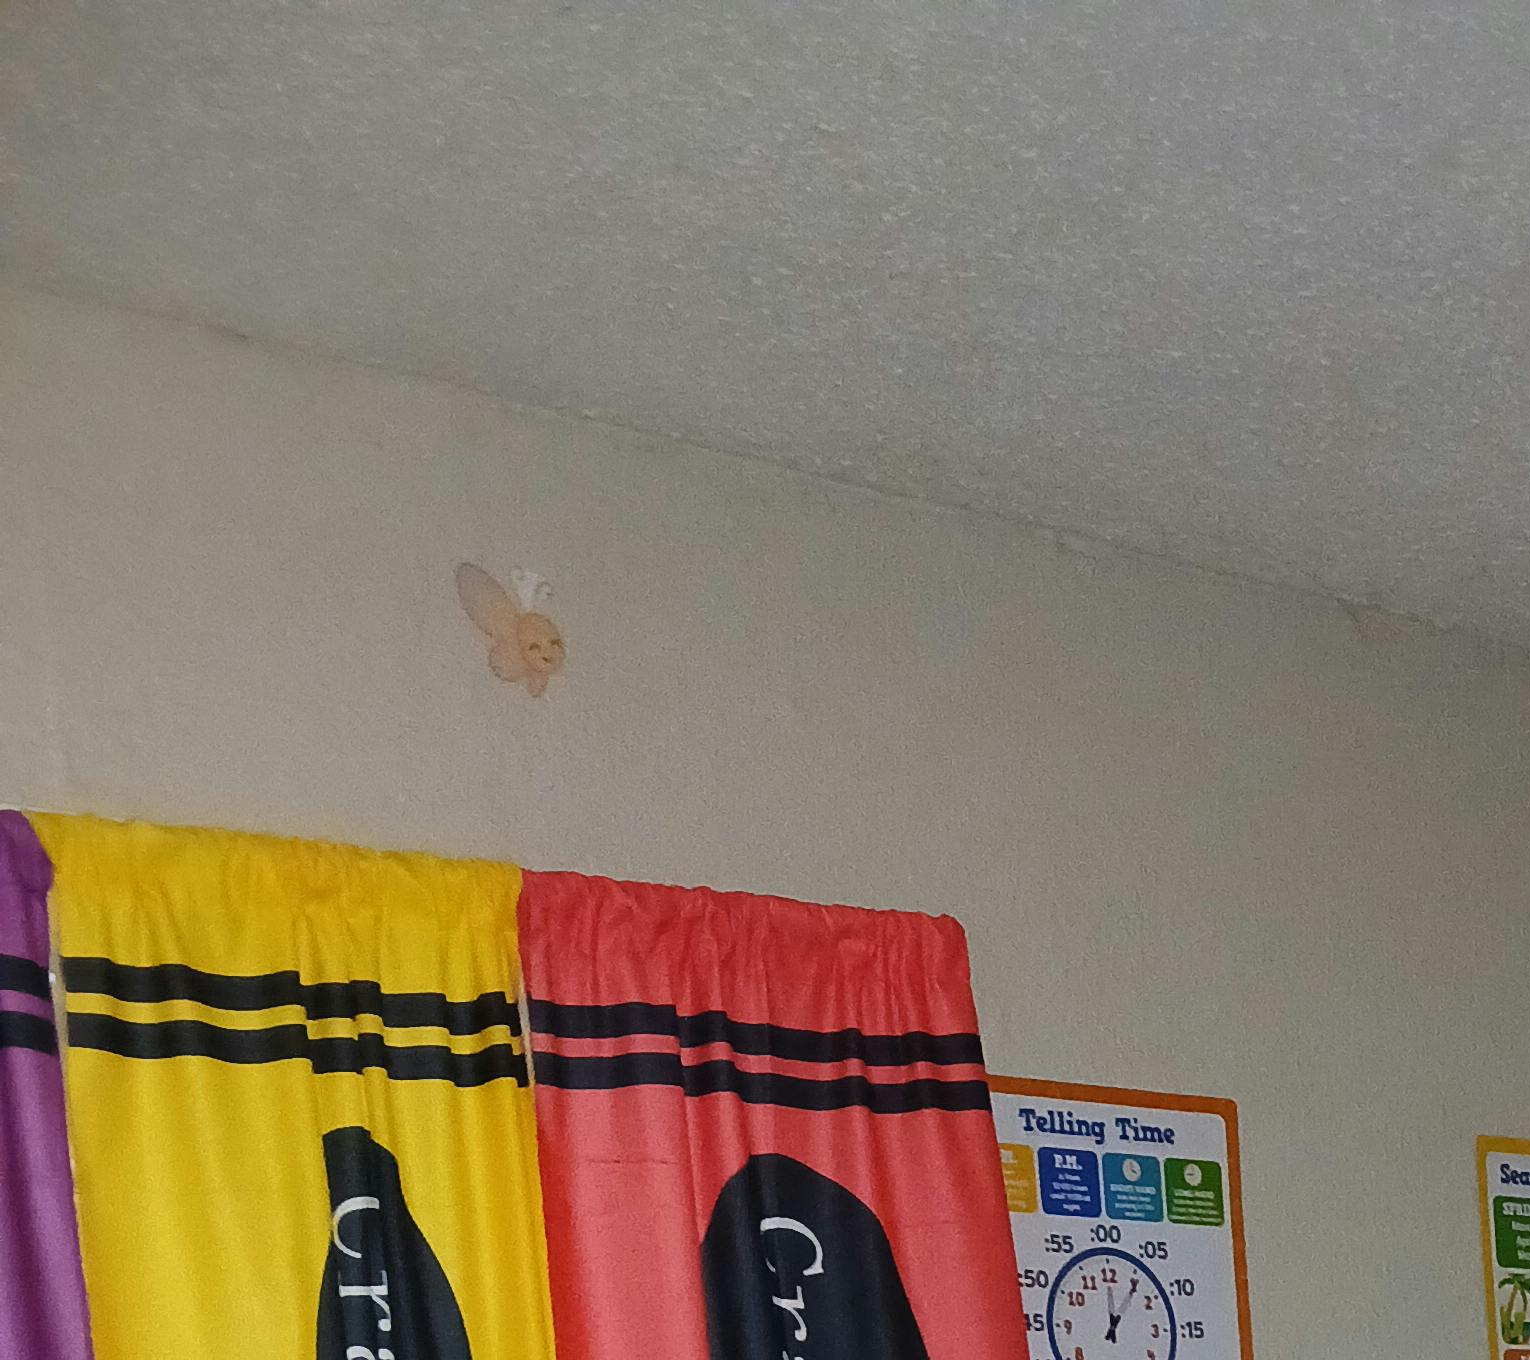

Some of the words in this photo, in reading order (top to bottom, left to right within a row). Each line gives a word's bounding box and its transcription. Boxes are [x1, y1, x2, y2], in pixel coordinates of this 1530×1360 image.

[1018, 1107, 1106, 1145] Telling
[1115, 1116, 1176, 1145] Time
[1090, 1225, 1121, 1244] :00
[1044, 1234, 1074, 1254] :55
[1138, 1241, 1169, 1260] :05
[1081, 1275, 1098, 1291] 11
[1101, 1268, 1118, 1284] 12
[1169, 1279, 1195, 1297] :10
[1067, 1291, 1085, 1307] 10
[1063, 1319, 1072, 1335] 9
[1150, 1323, 1160, 1338] 3
[1181, 1321, 1205, 1339] :15
